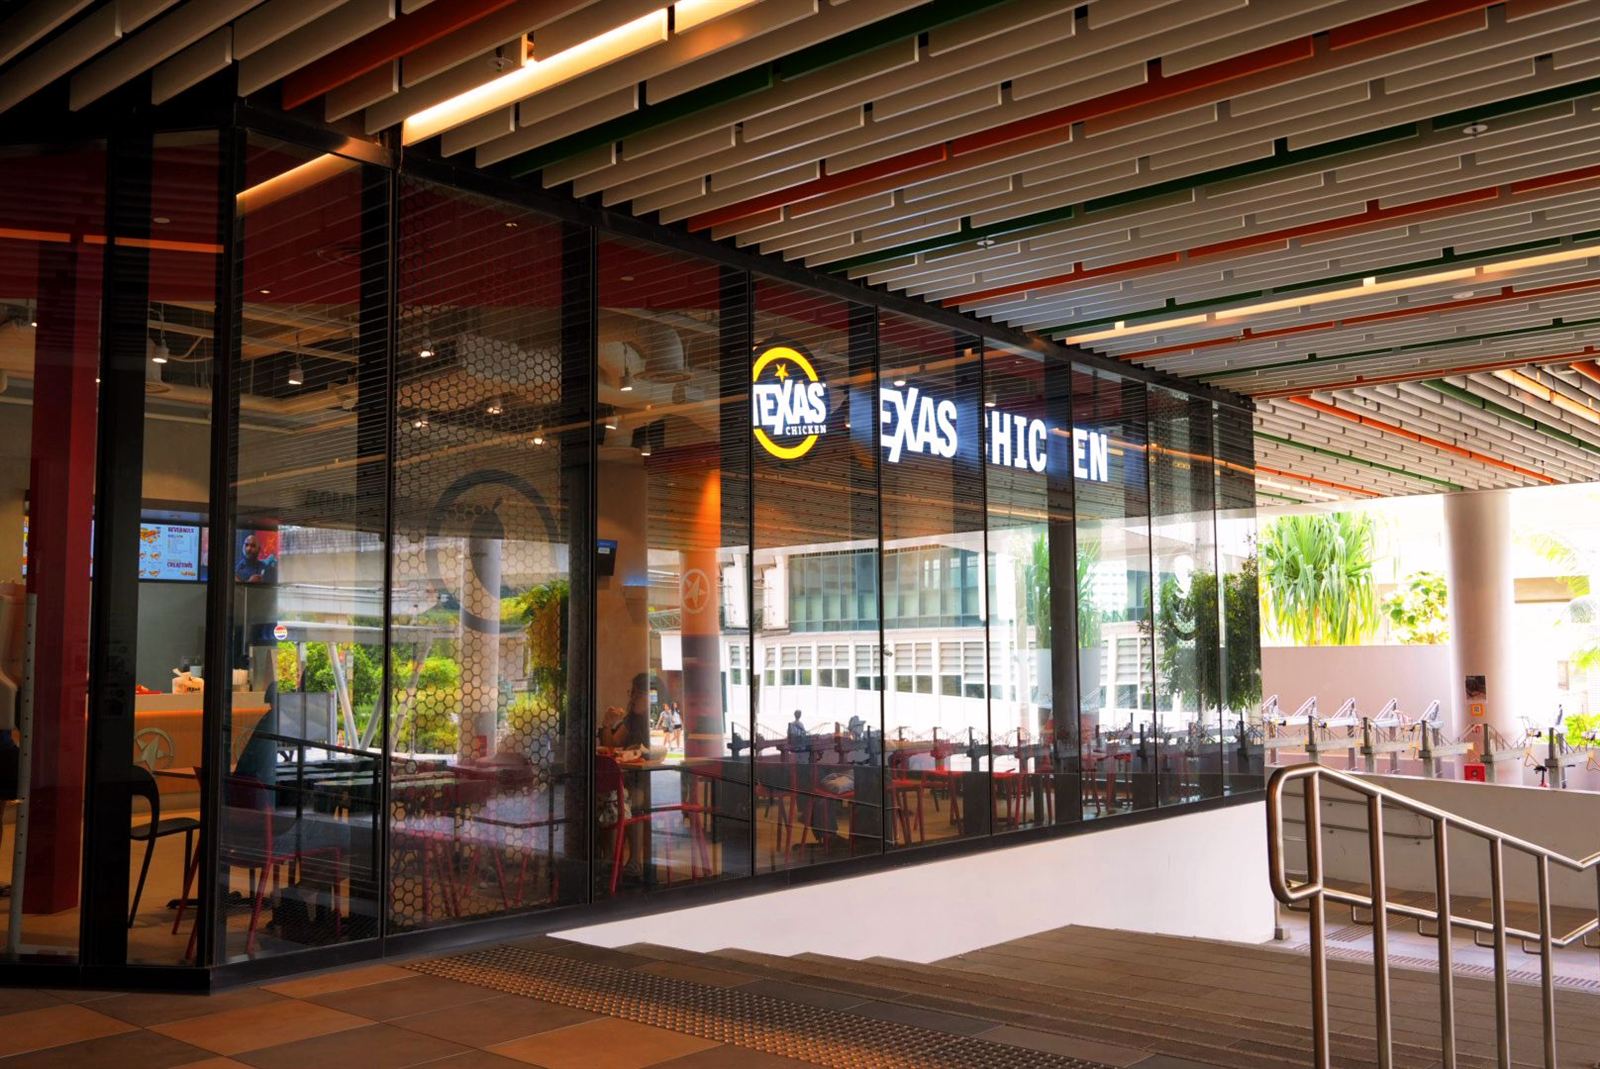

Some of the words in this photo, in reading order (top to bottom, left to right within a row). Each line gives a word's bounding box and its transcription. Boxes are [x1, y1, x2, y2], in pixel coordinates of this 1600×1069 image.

[753, 380, 827, 435] TEXAS
[785, 424, 827, 436] CHICKEN
[880, 387, 958, 463] EXAS
[985, 411, 1108, 482] HICEN
